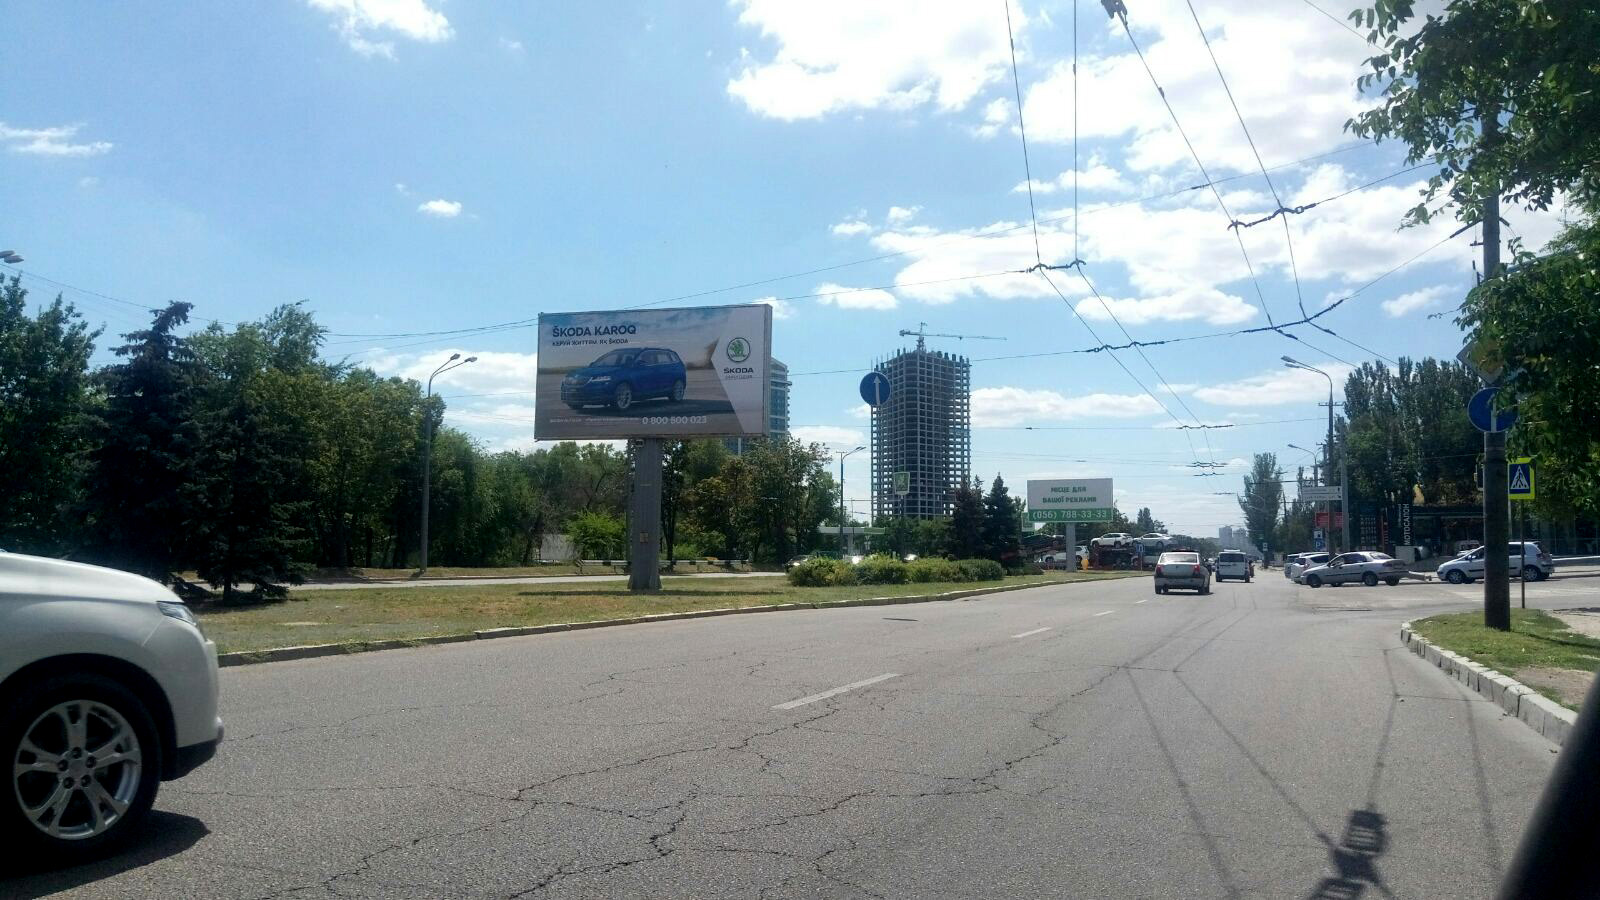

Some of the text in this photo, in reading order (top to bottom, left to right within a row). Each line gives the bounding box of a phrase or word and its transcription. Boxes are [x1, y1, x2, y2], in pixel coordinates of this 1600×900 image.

[552, 325, 637, 337] ŠKODA KAROQ
[608, 337, 629, 345] ŠKODA
[723, 366, 754, 374] ŠKODA
[642, 417, 649, 425] 0
[651, 416, 668, 425] 800
[690, 415, 708, 424] 023
[1032, 510, 1057, 520] (056)
[1403, 503, 1411, 546] МОТОСАЛОН
